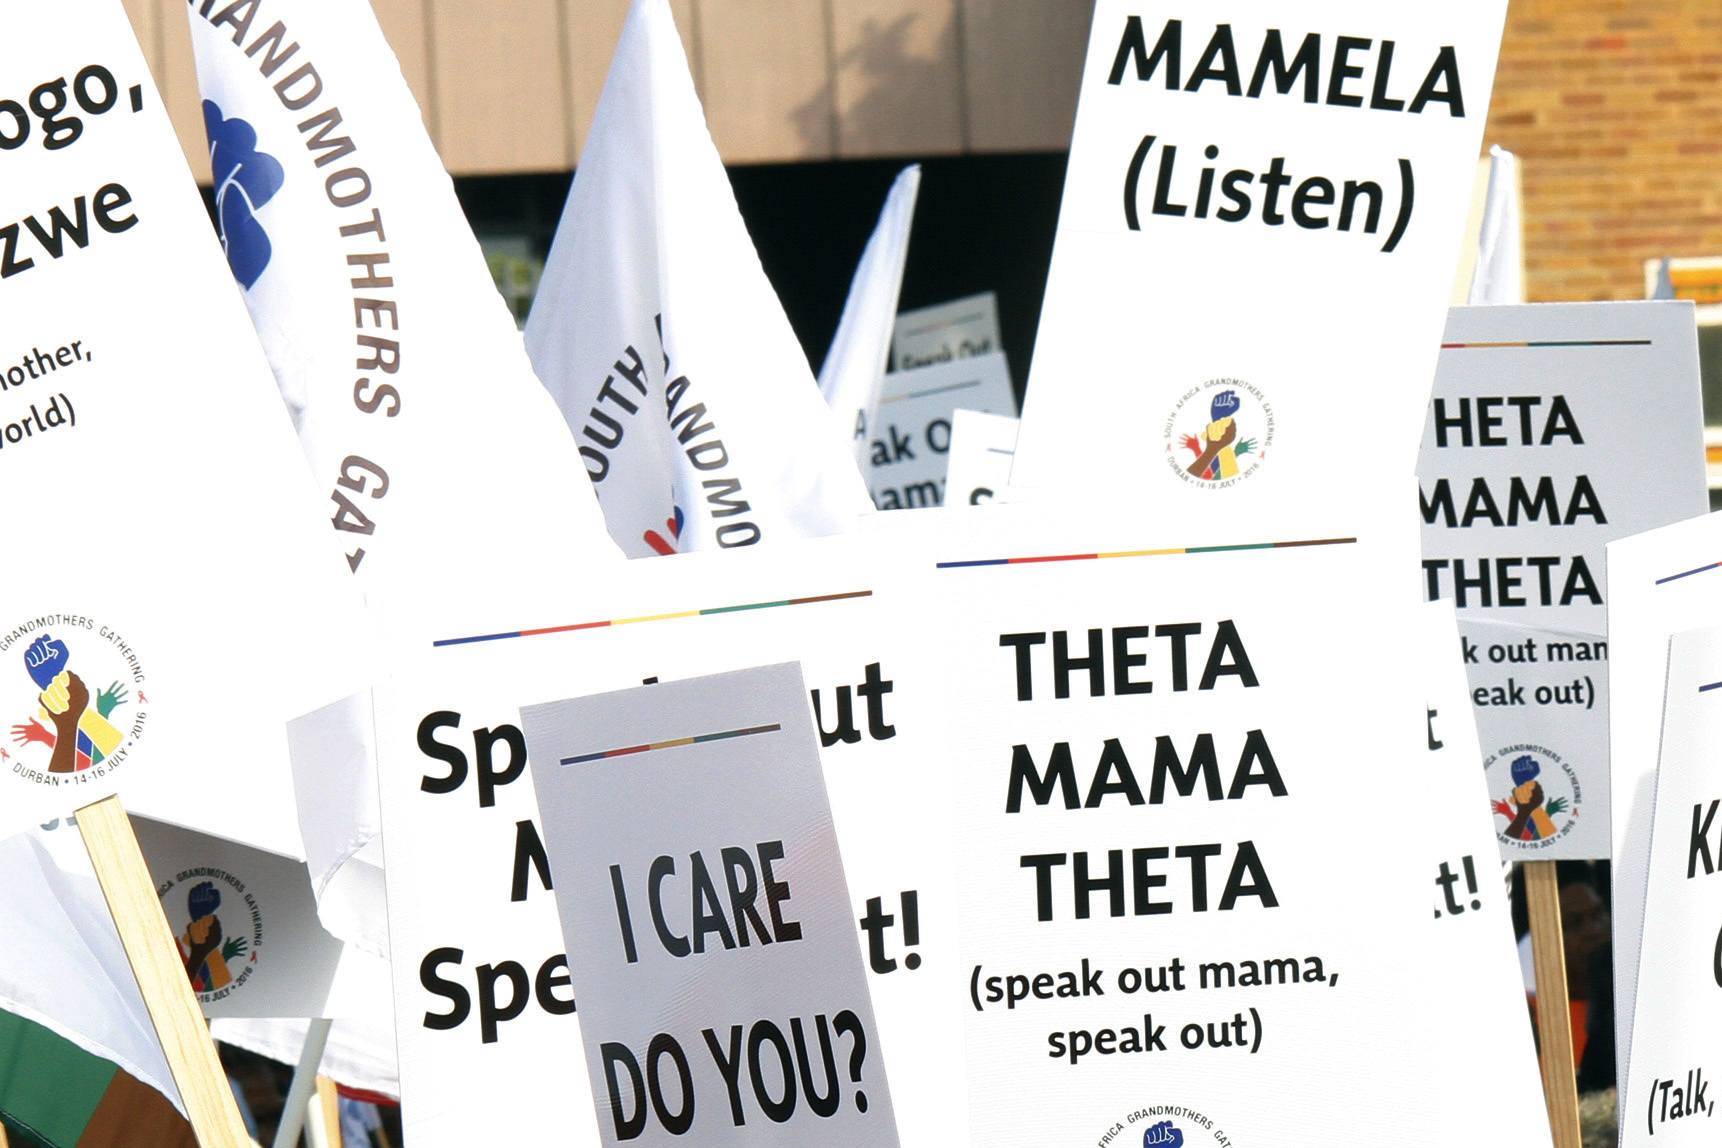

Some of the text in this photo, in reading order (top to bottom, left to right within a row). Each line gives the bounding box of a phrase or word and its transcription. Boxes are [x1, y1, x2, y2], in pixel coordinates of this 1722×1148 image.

[1107, 15, 1467, 118] MAMELA
[1123, 134, 1416, 252] (Listen)
[579, 345, 648, 500] OUTH
[656, 350, 761, 549] ANDMO
[1432, 395, 1584, 447] HETA
[1421, 555, 1604, 608] THETA
[0, 614, 146, 683] GRANDMOTHERS GATHERING
[1000, 618, 1260, 703] THETA
[1488, 638, 1537, 664] out
[1470, 676, 1595, 710] eak out)
[12, 711, 147, 786] DURBAN 14-16 JULY 2016
[1005, 728, 1289, 814] MAMA
[176, 866, 263, 947] GRANDMOTHERS GATHERING
[608, 864, 638, 965] I
[647, 839, 803, 959] CARE
[1019, 840, 1280, 923] THETA
[212, 988, 231, 1002] JULY
[235, 966, 253, 987] 2016
[969, 952, 1340, 1012] (speak out mama,
[1047, 1008, 1264, 1065] speak out)
[600, 1009, 870, 1142] DO YOU?
[1646, 1077, 1714, 1136] (Talk,
[1127, 1105, 1214, 1130] GRANDMOTHERS
